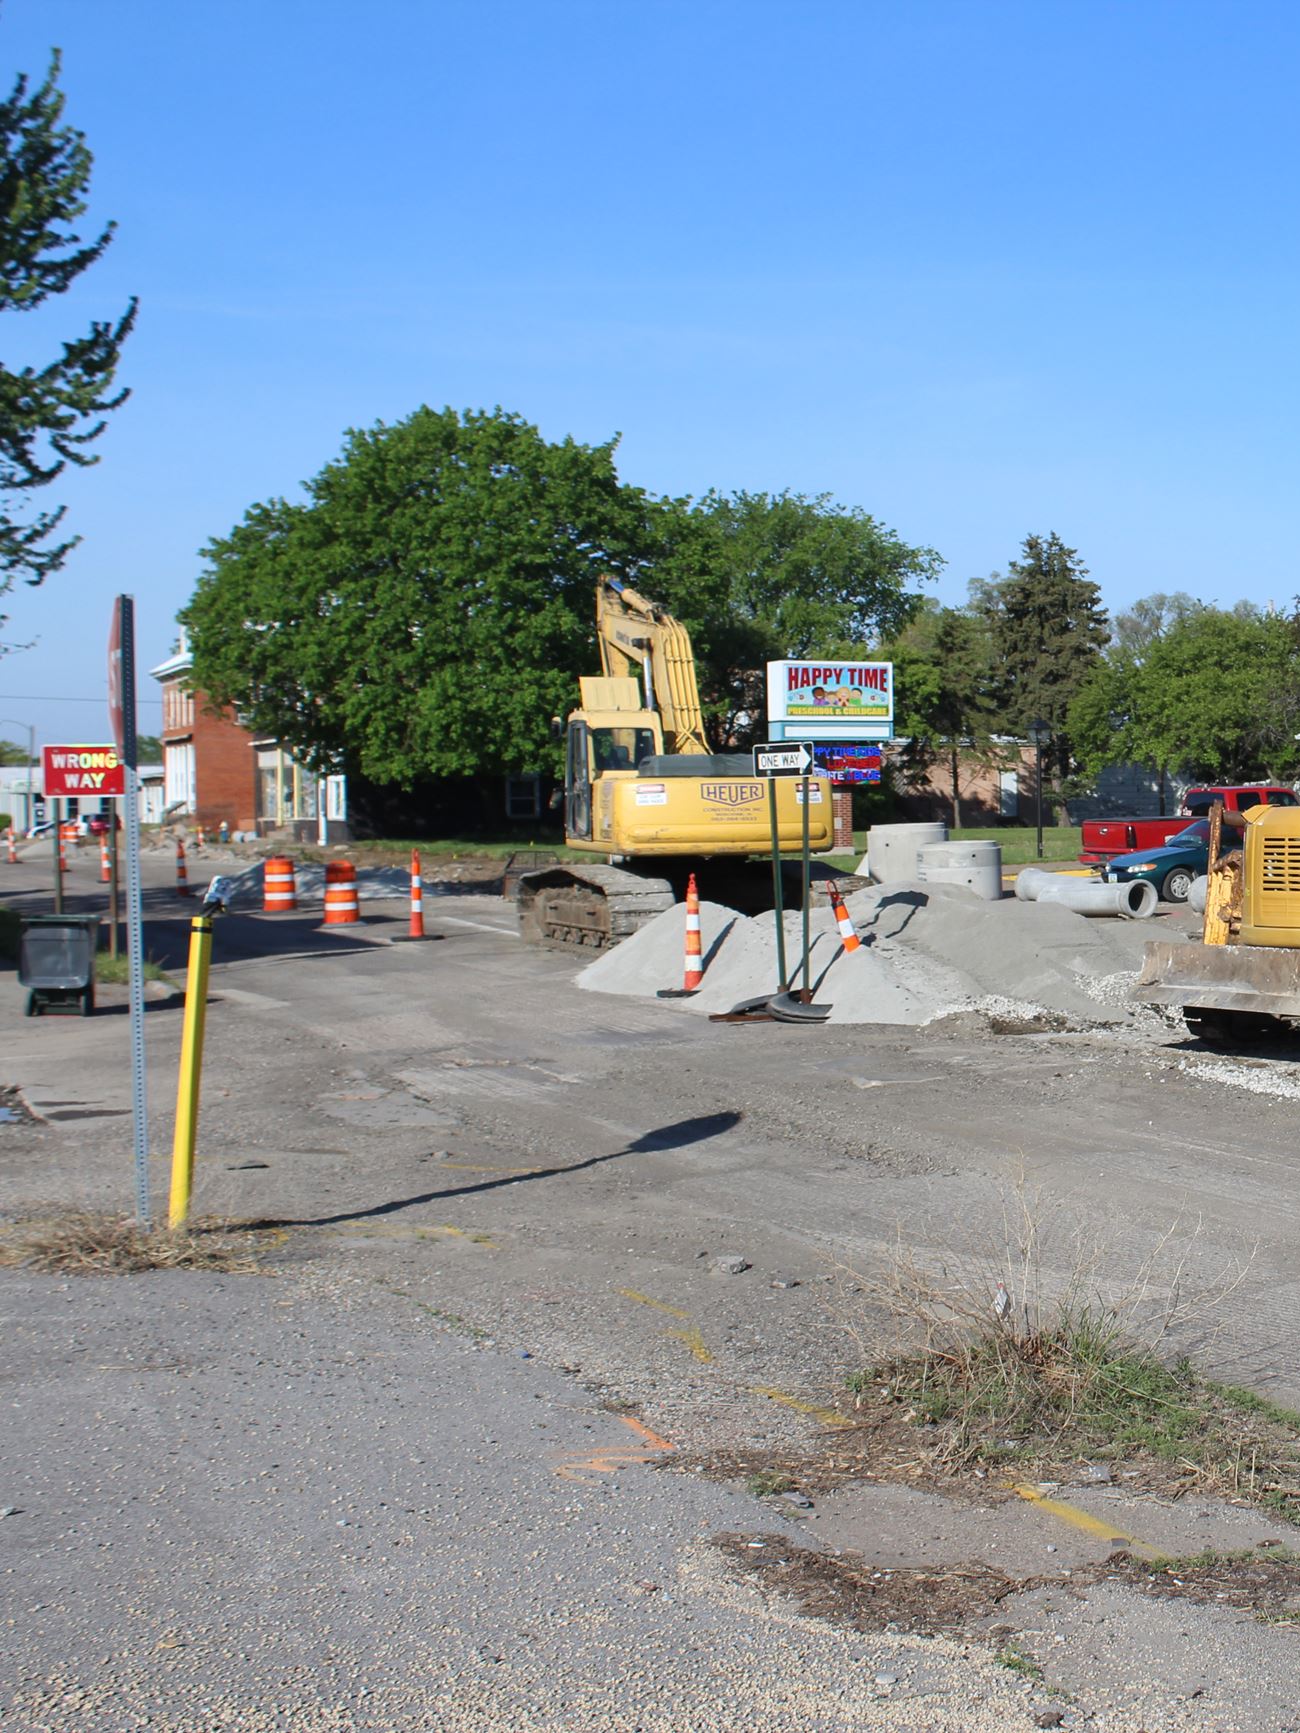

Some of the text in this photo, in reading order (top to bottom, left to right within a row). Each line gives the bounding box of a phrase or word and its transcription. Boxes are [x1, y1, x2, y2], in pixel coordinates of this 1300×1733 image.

[788, 667, 888, 692] HAPPY TIME
[788, 706, 833, 715] PRESCHOOL
[843, 706, 887, 715] CHILDCARE
[51, 752, 117, 769] WRONG
[761, 754, 799, 768] ONE WAY
[64, 772, 106, 788] WAY
[855, 770, 880, 780] BLUE
[706, 785, 759, 803] HEUER
